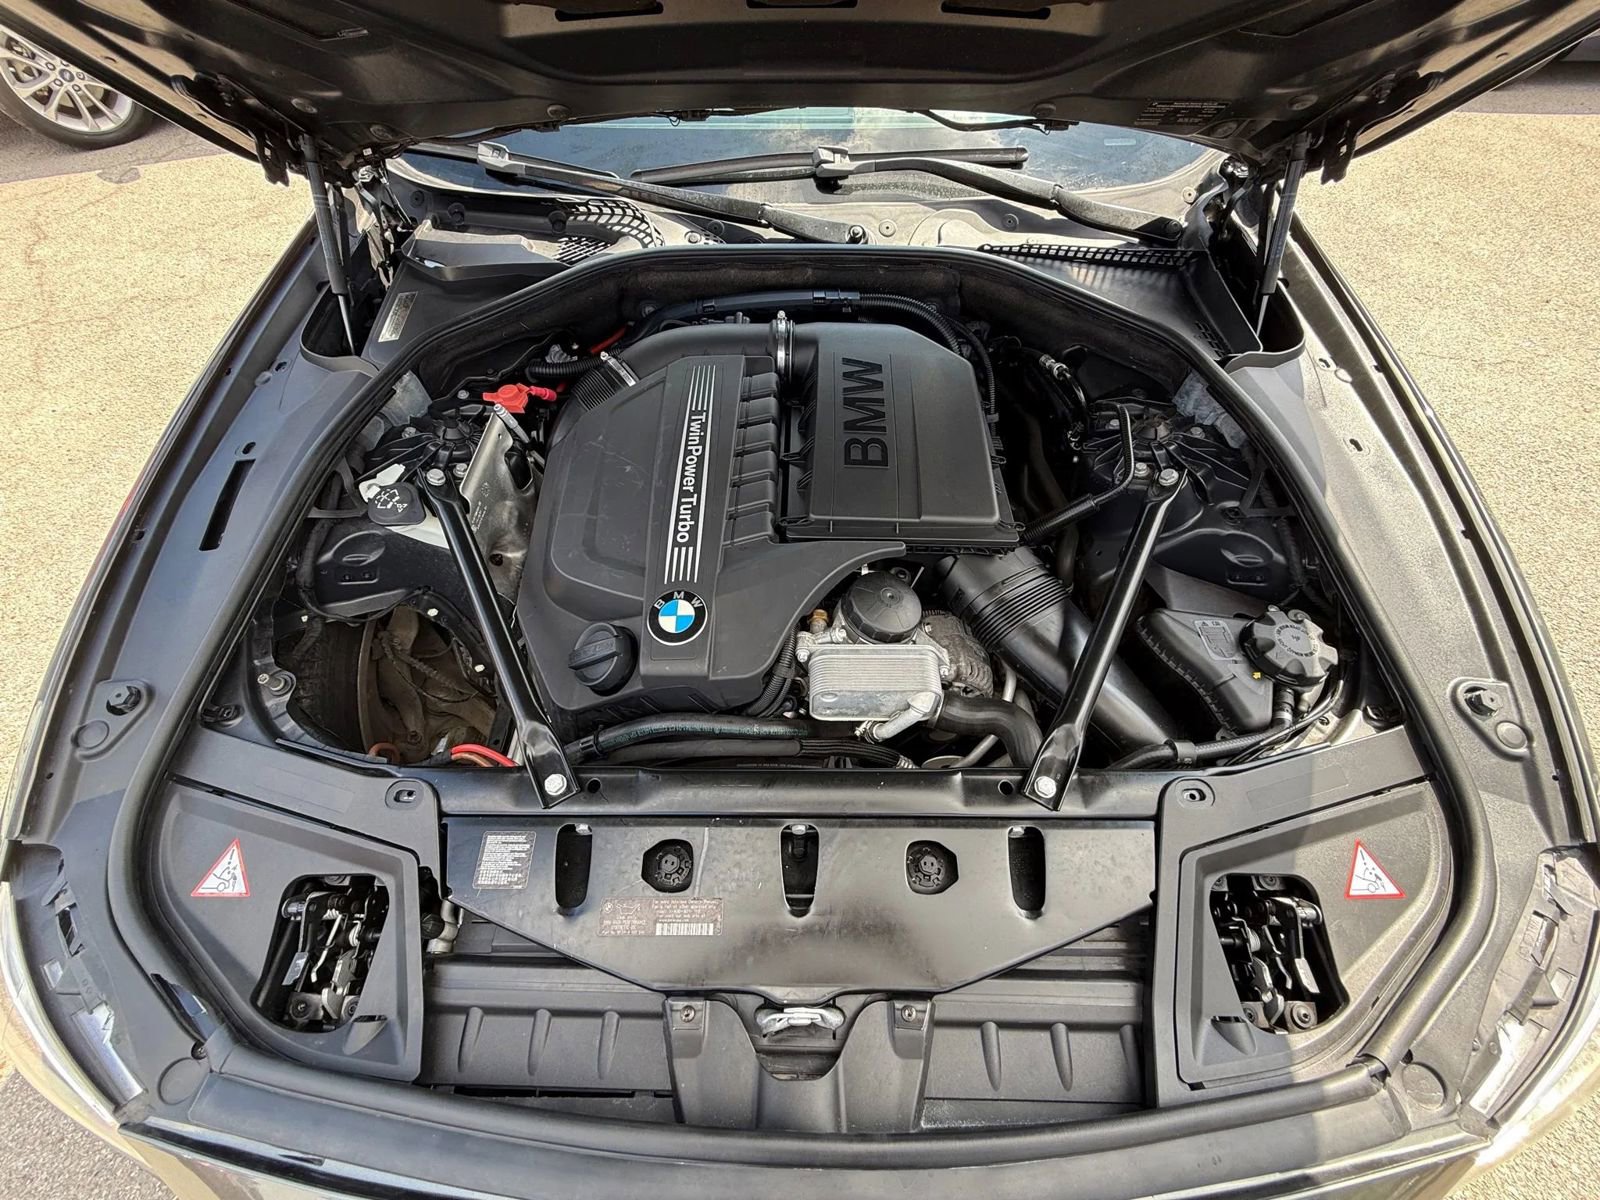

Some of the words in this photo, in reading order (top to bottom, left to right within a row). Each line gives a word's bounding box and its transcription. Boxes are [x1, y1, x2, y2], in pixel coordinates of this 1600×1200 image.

[842, 357, 888, 468] BMW
[682, 412, 706, 493] TwinPower
[676, 493, 698, 543] Turbo
[653, 591, 704, 610] BMW
